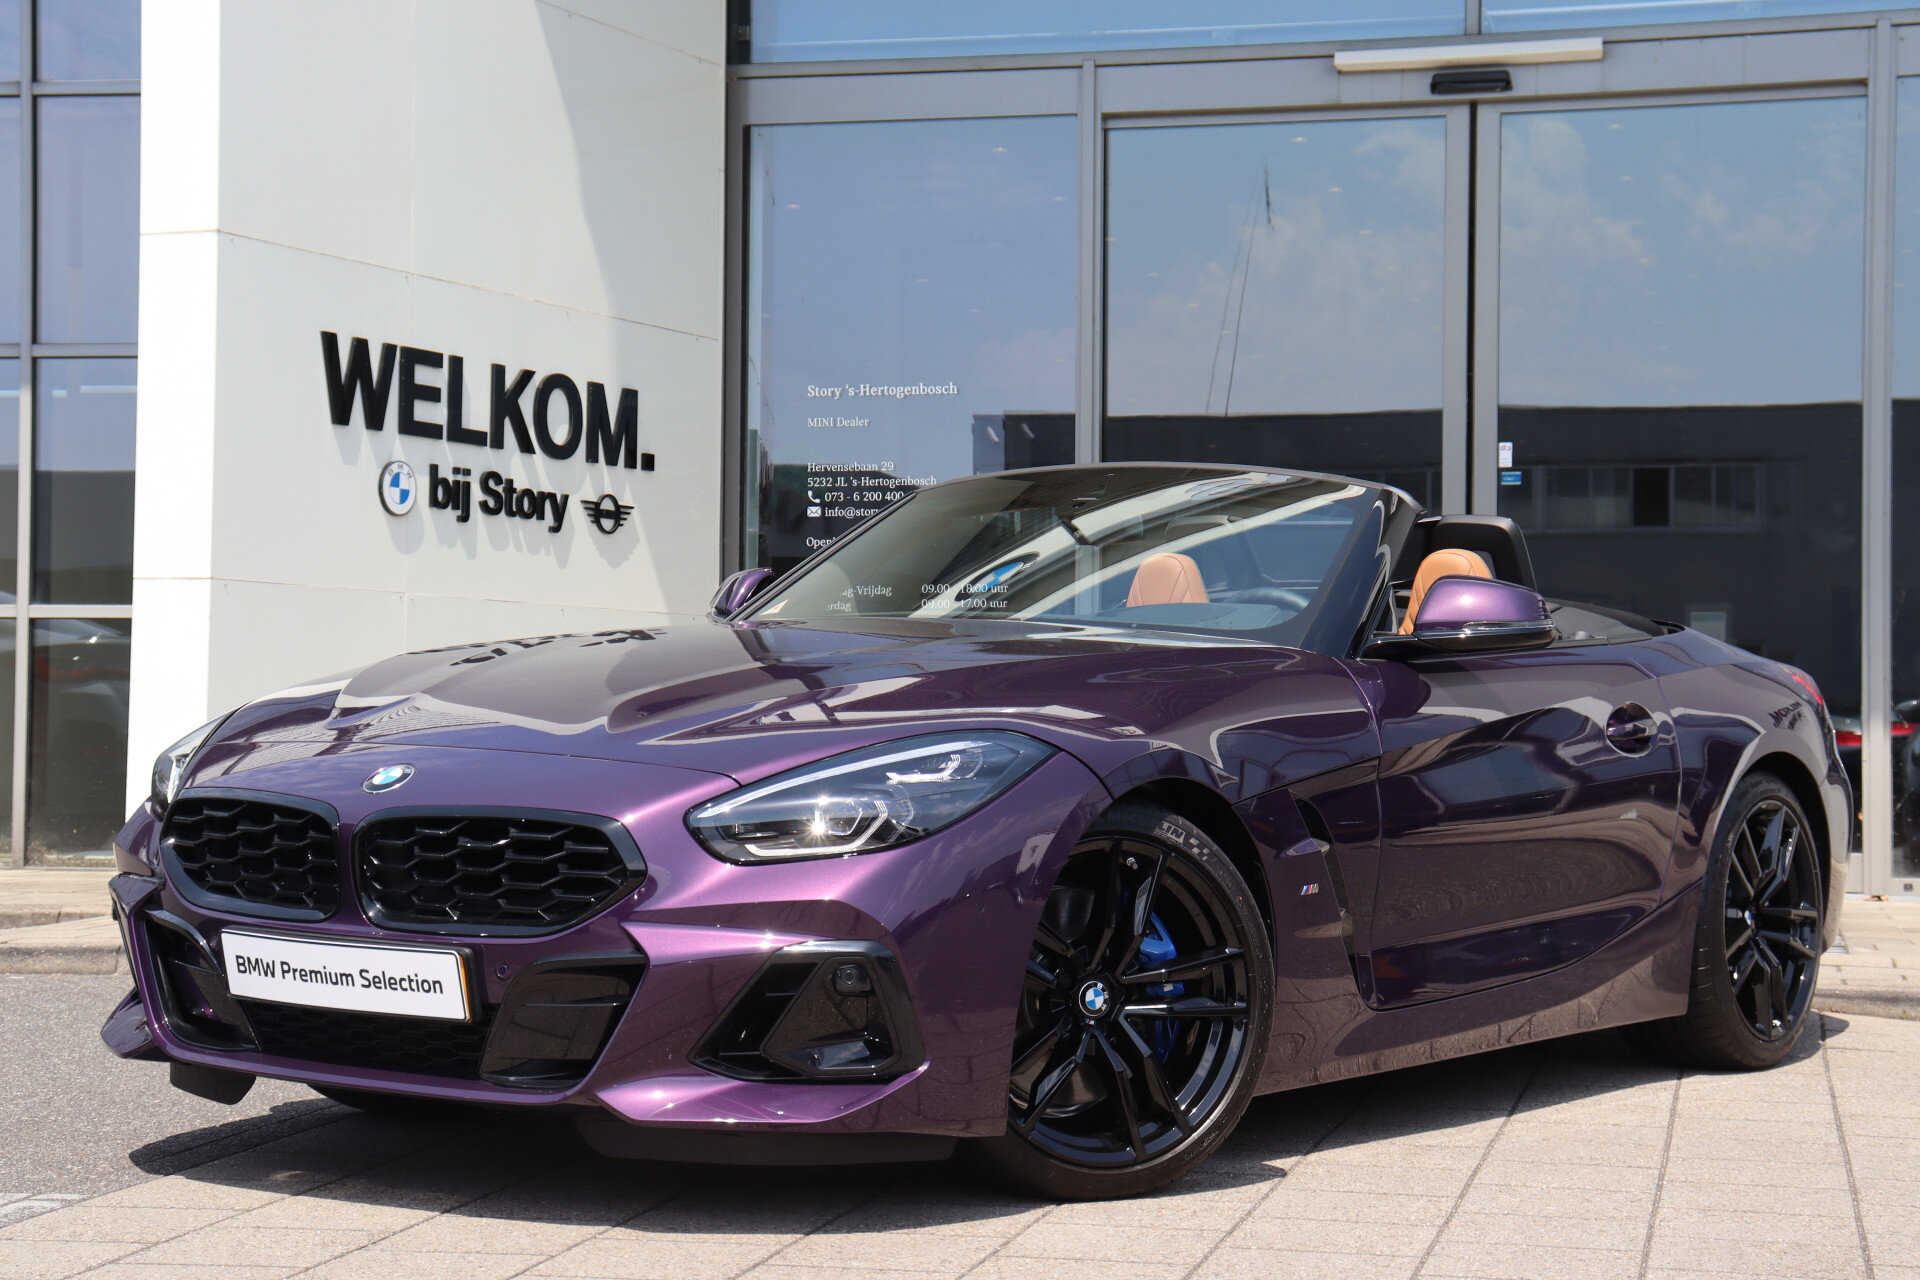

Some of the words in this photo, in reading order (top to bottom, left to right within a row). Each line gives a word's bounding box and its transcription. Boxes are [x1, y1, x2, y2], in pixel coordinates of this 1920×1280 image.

[807, 384, 842, 400] Story
[320, 331, 655, 472] WELKOM.
[807, 417, 834, 428] MINI
[836, 417, 870, 428] Dealer
[807, 462, 878, 472] Hervensebaan
[881, 461, 894, 471] 29
[807, 477, 833, 487] 5232
[835, 477, 848, 487] JL
[429, 463, 471, 523] bij
[479, 470, 569, 533] Story
[825, 491, 844, 502] 073
[853, 491, 860, 501] 6
[862, 491, 882, 502] 200
[840, 585, 892, 598] ag-Vrijdag
[921, 583, 950, 594] 09.00
[991, 585, 1009, 594] uur
[827, 601, 852, 612] rdag
[960, 598, 987, 608] 17.00
[989, 600, 1008, 608] uur
[235, 955, 276, 979] BMW
[281, 961, 356, 988] Premium
[360, 968, 444, 995] Selection
